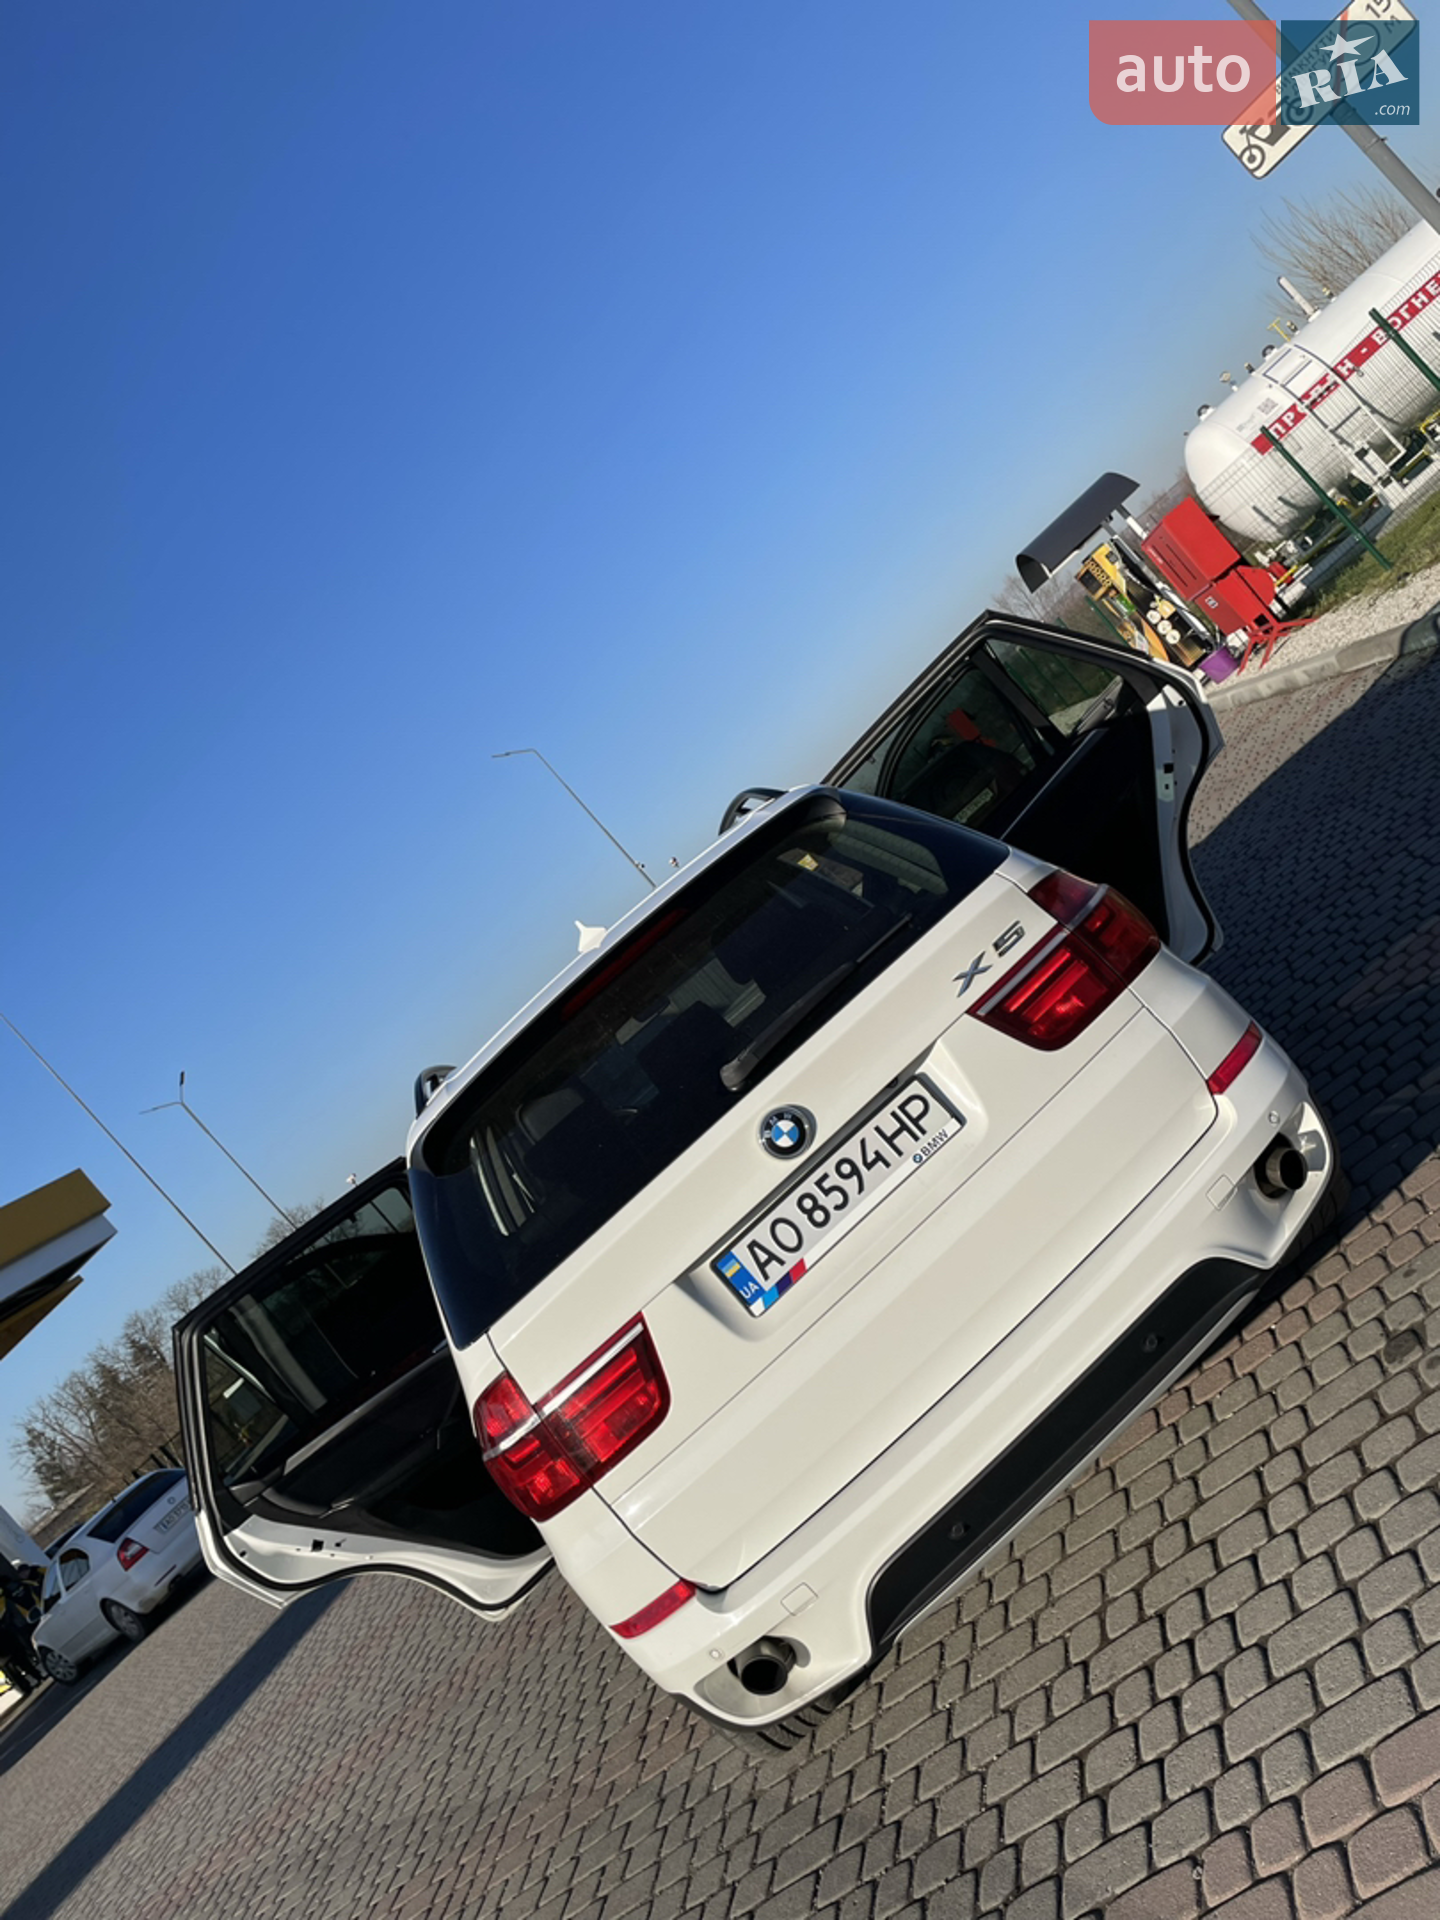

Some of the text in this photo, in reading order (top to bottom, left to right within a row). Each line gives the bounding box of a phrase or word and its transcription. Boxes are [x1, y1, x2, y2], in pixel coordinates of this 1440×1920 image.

[1371, 272, 1440, 345] ВОГНЕ
[921, 1129, 949, 1156] BMW
[796, 1137, 891, 1228] 8594
[740, 1281, 760, 1299] UA
